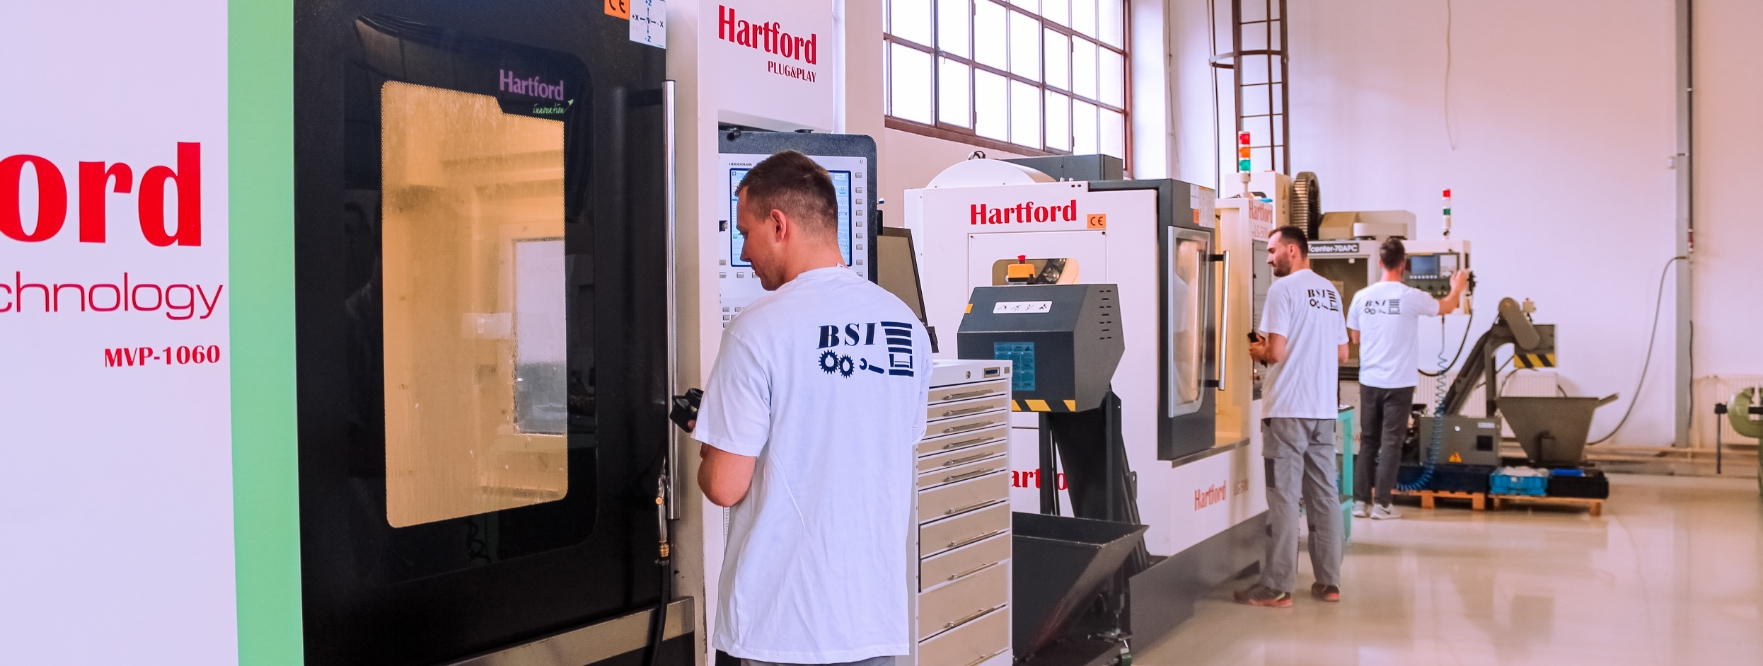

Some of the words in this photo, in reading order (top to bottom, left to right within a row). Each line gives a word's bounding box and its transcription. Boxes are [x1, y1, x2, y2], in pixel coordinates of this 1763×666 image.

[718, 4, 817, 65] Hartford
[499, 69, 564, 100] Hartford
[767, 60, 817, 83] PLUG&PLAY
[970, 199, 1077, 225] Hartford
[1308, 289, 1326, 298] BSI
[816, 322, 877, 349] BSI
[104, 345, 221, 367] MVP-1060
[1194, 480, 1227, 511] Hartford
